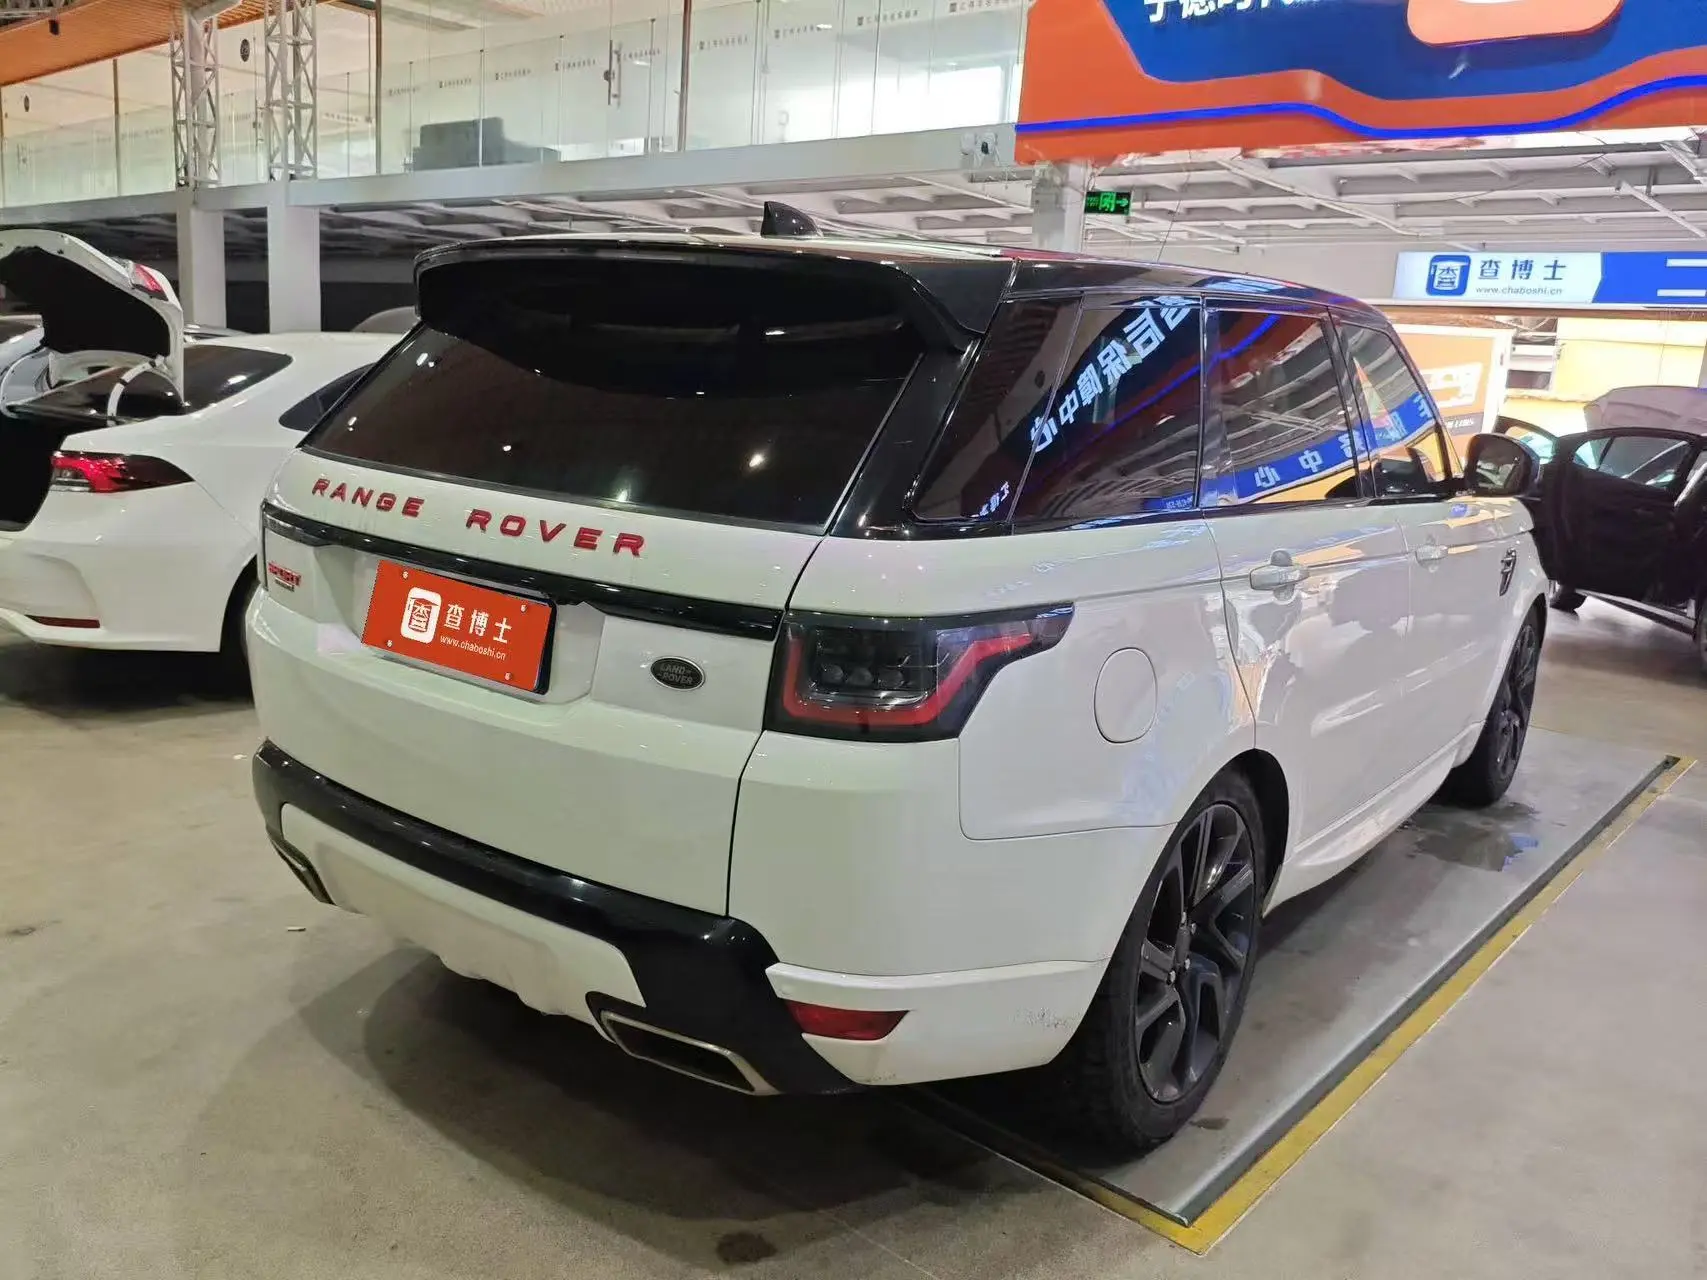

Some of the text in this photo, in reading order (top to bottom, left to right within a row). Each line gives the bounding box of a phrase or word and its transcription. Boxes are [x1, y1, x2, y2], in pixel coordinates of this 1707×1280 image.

[1478, 259, 1566, 281] 查博士
[1476, 286, 1562, 296] www.chaboshi.cn
[312, 478, 646, 557] RANGE ROVER
[444, 603, 512, 644] 查博士
[440, 635, 506, 661] www.chaboshi.cn
[660, 663, 686, 674] LAND
[662, 672, 693, 685] ROVER
